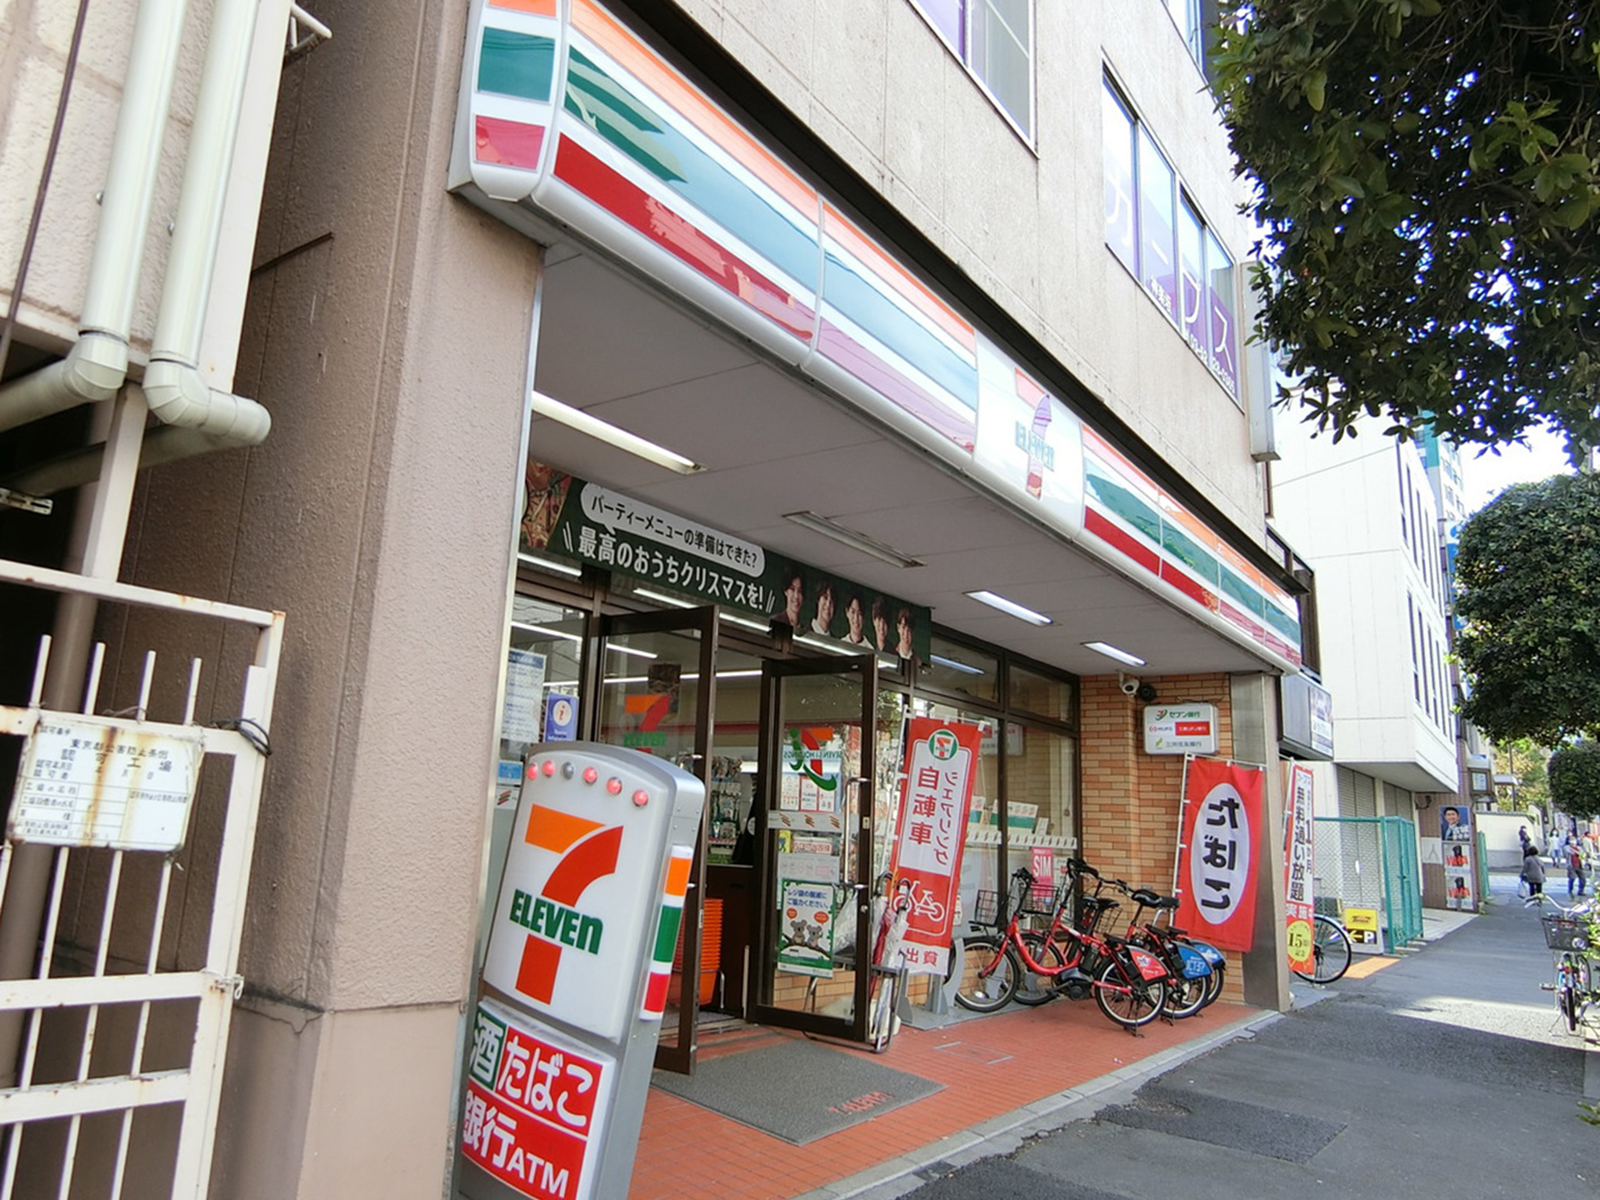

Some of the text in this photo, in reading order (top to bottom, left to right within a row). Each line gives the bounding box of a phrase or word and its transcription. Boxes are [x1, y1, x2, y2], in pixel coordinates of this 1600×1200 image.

[1032, 855, 1052, 877] SIM
[469, 1012, 504, 1085] 酒
[497, 1035, 594, 1128] たばこ
